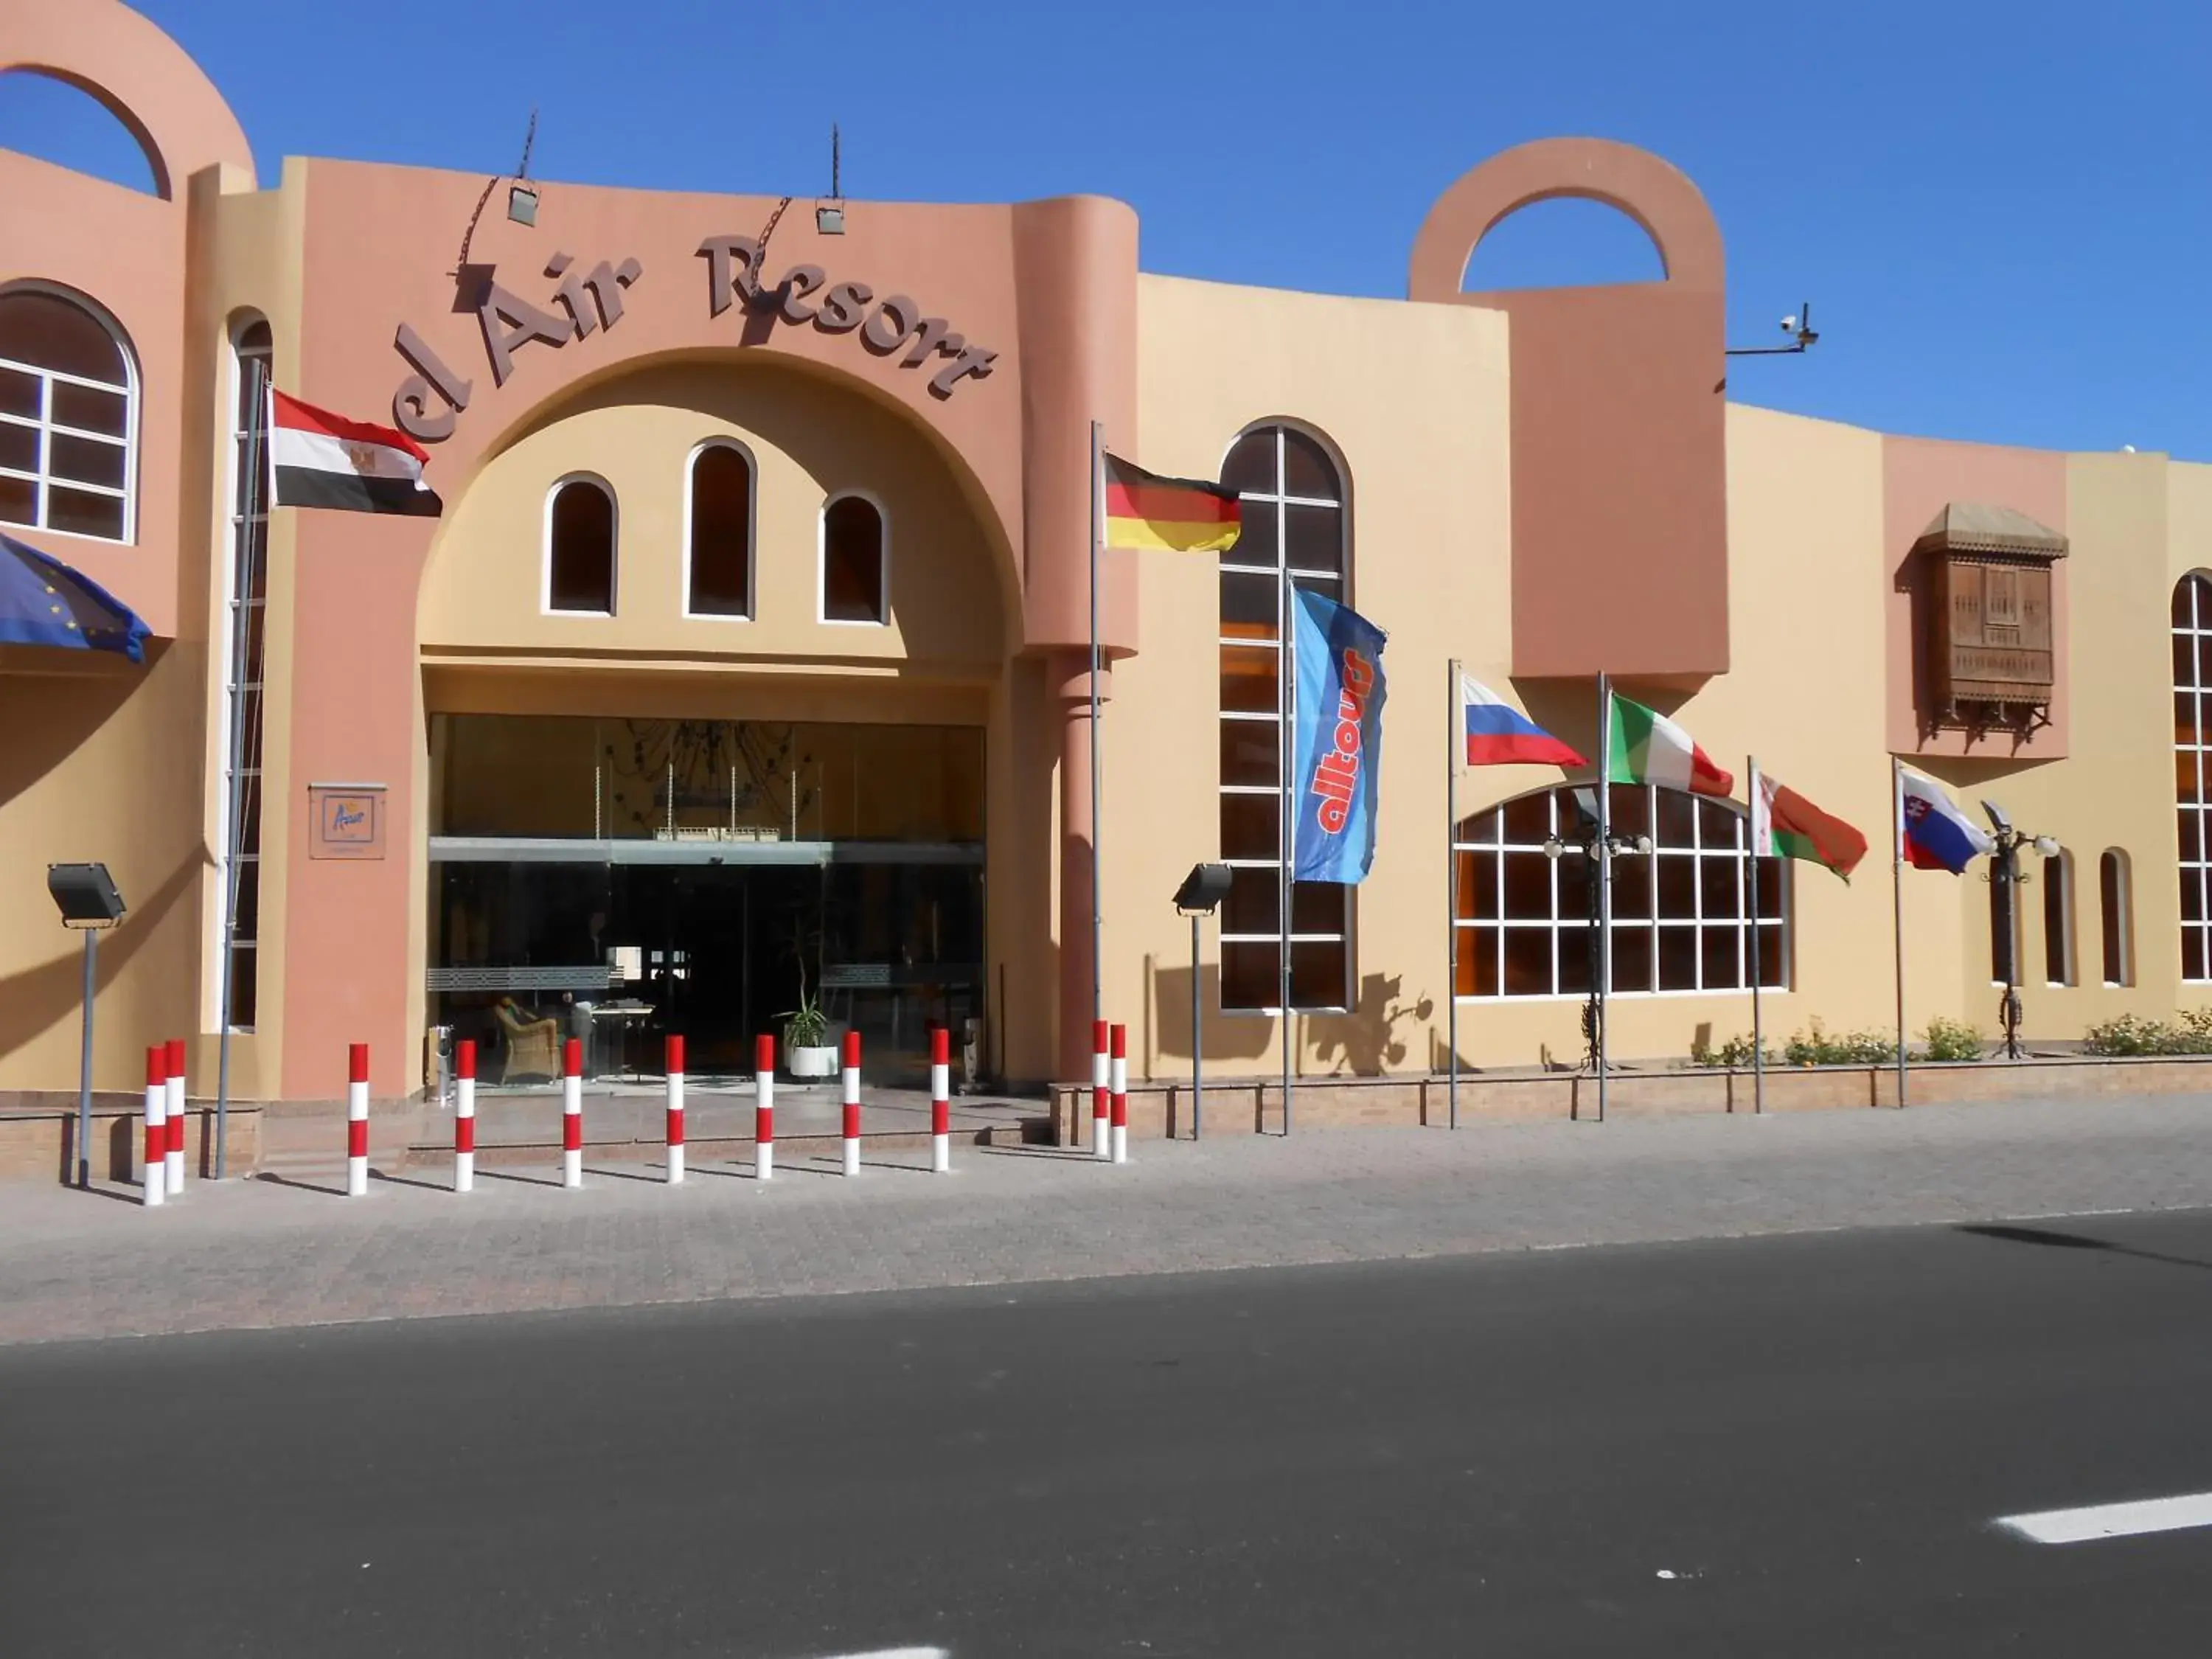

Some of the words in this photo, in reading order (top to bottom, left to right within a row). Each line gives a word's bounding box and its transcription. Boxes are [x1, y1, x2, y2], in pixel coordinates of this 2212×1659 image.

[392, 321, 473, 444] el
[473, 251, 643, 389] Air
[694, 234, 999, 402] Resort
